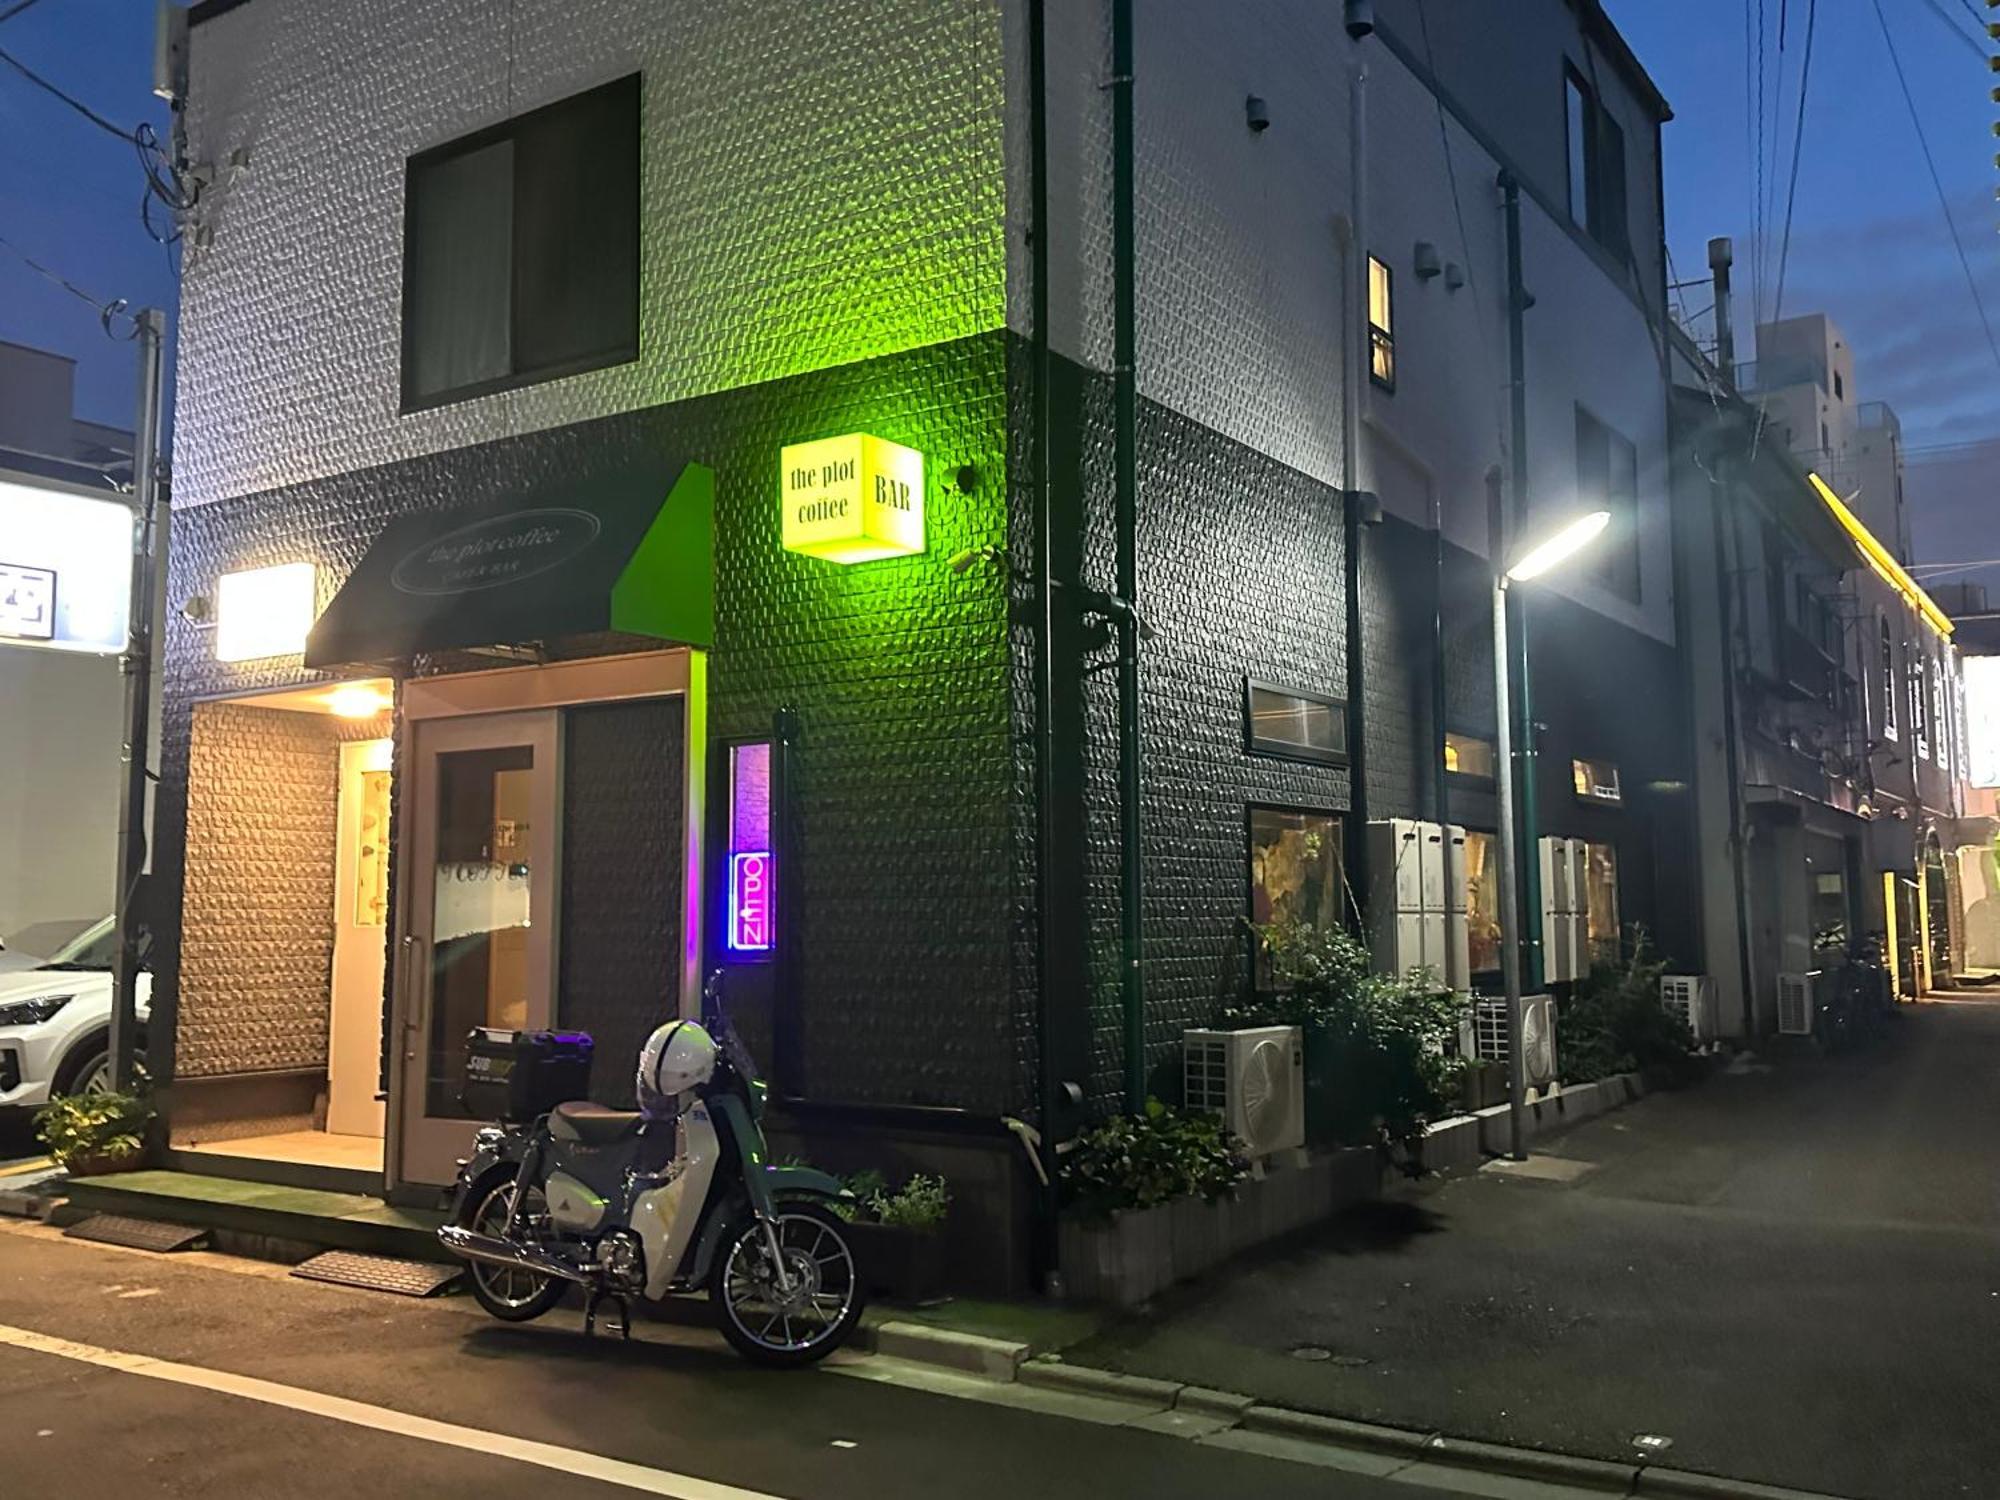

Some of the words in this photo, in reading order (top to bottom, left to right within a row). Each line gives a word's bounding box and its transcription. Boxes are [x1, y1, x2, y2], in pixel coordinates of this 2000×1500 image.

[791, 467, 816, 490] the
[823, 458, 854, 488] plot
[875, 474, 911, 512] BAR
[743, 857, 764, 945] OPEN
